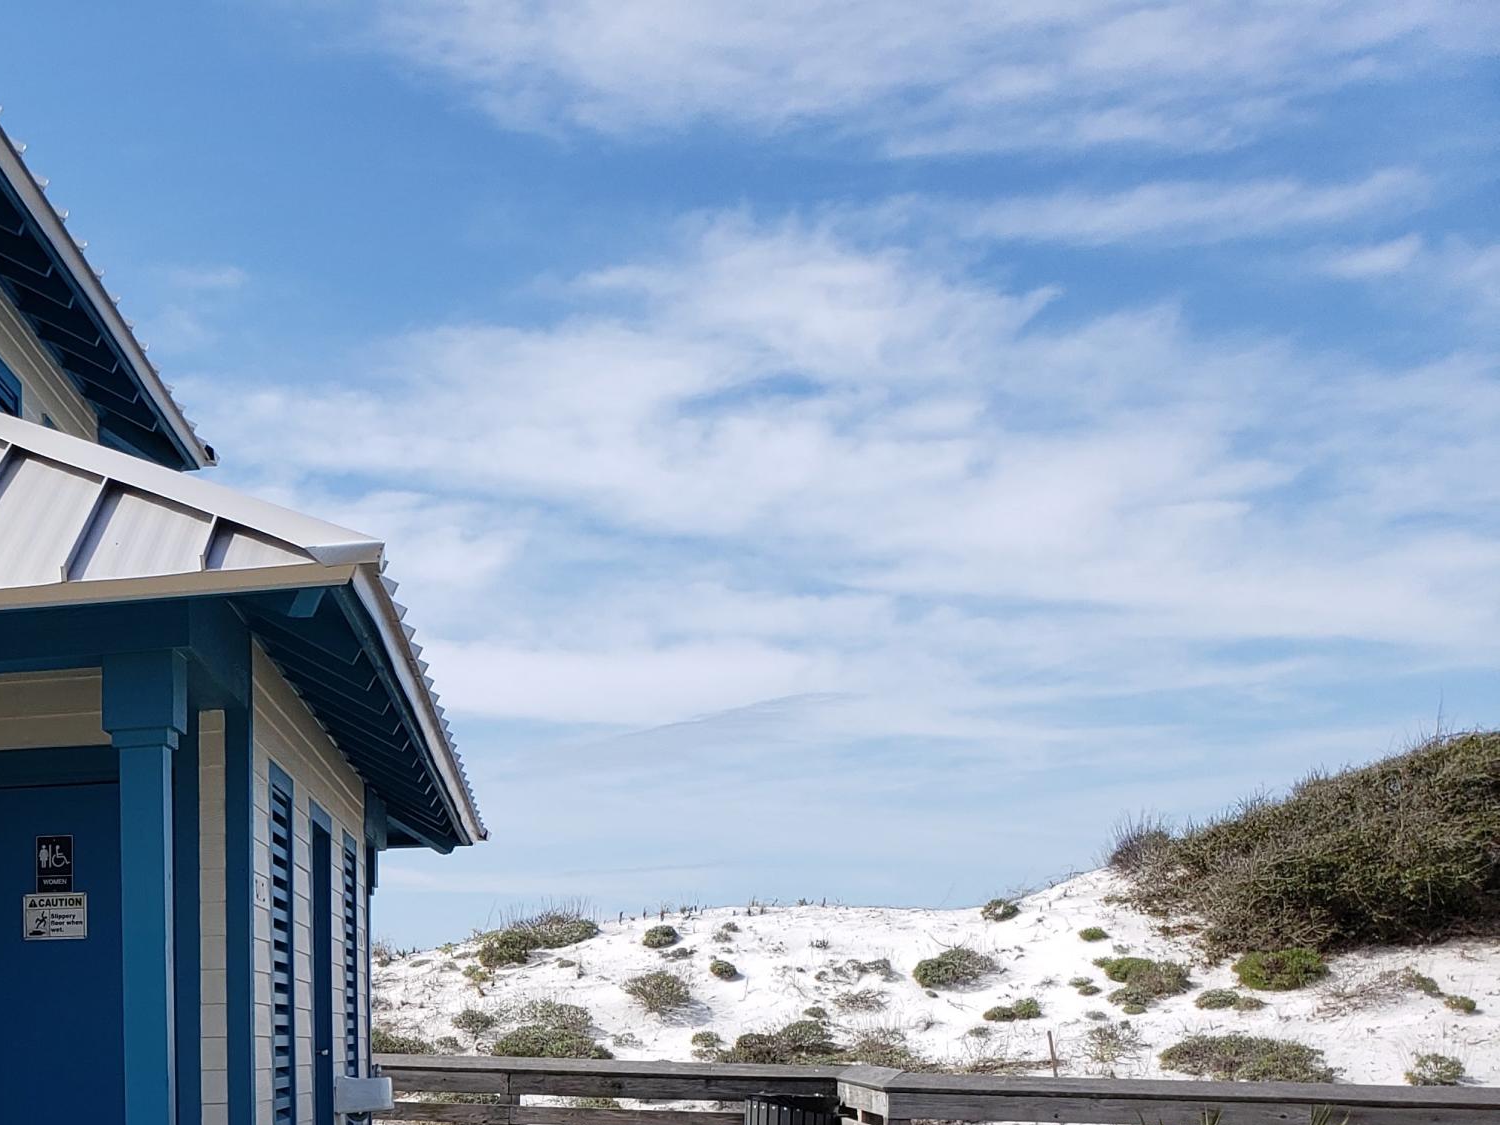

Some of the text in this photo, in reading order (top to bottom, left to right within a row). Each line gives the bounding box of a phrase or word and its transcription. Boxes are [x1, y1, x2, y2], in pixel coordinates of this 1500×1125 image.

[42, 878, 68, 886] WOMEN
[38, 897, 82, 907] CAUTION
[50, 913, 76, 921] Slippery
